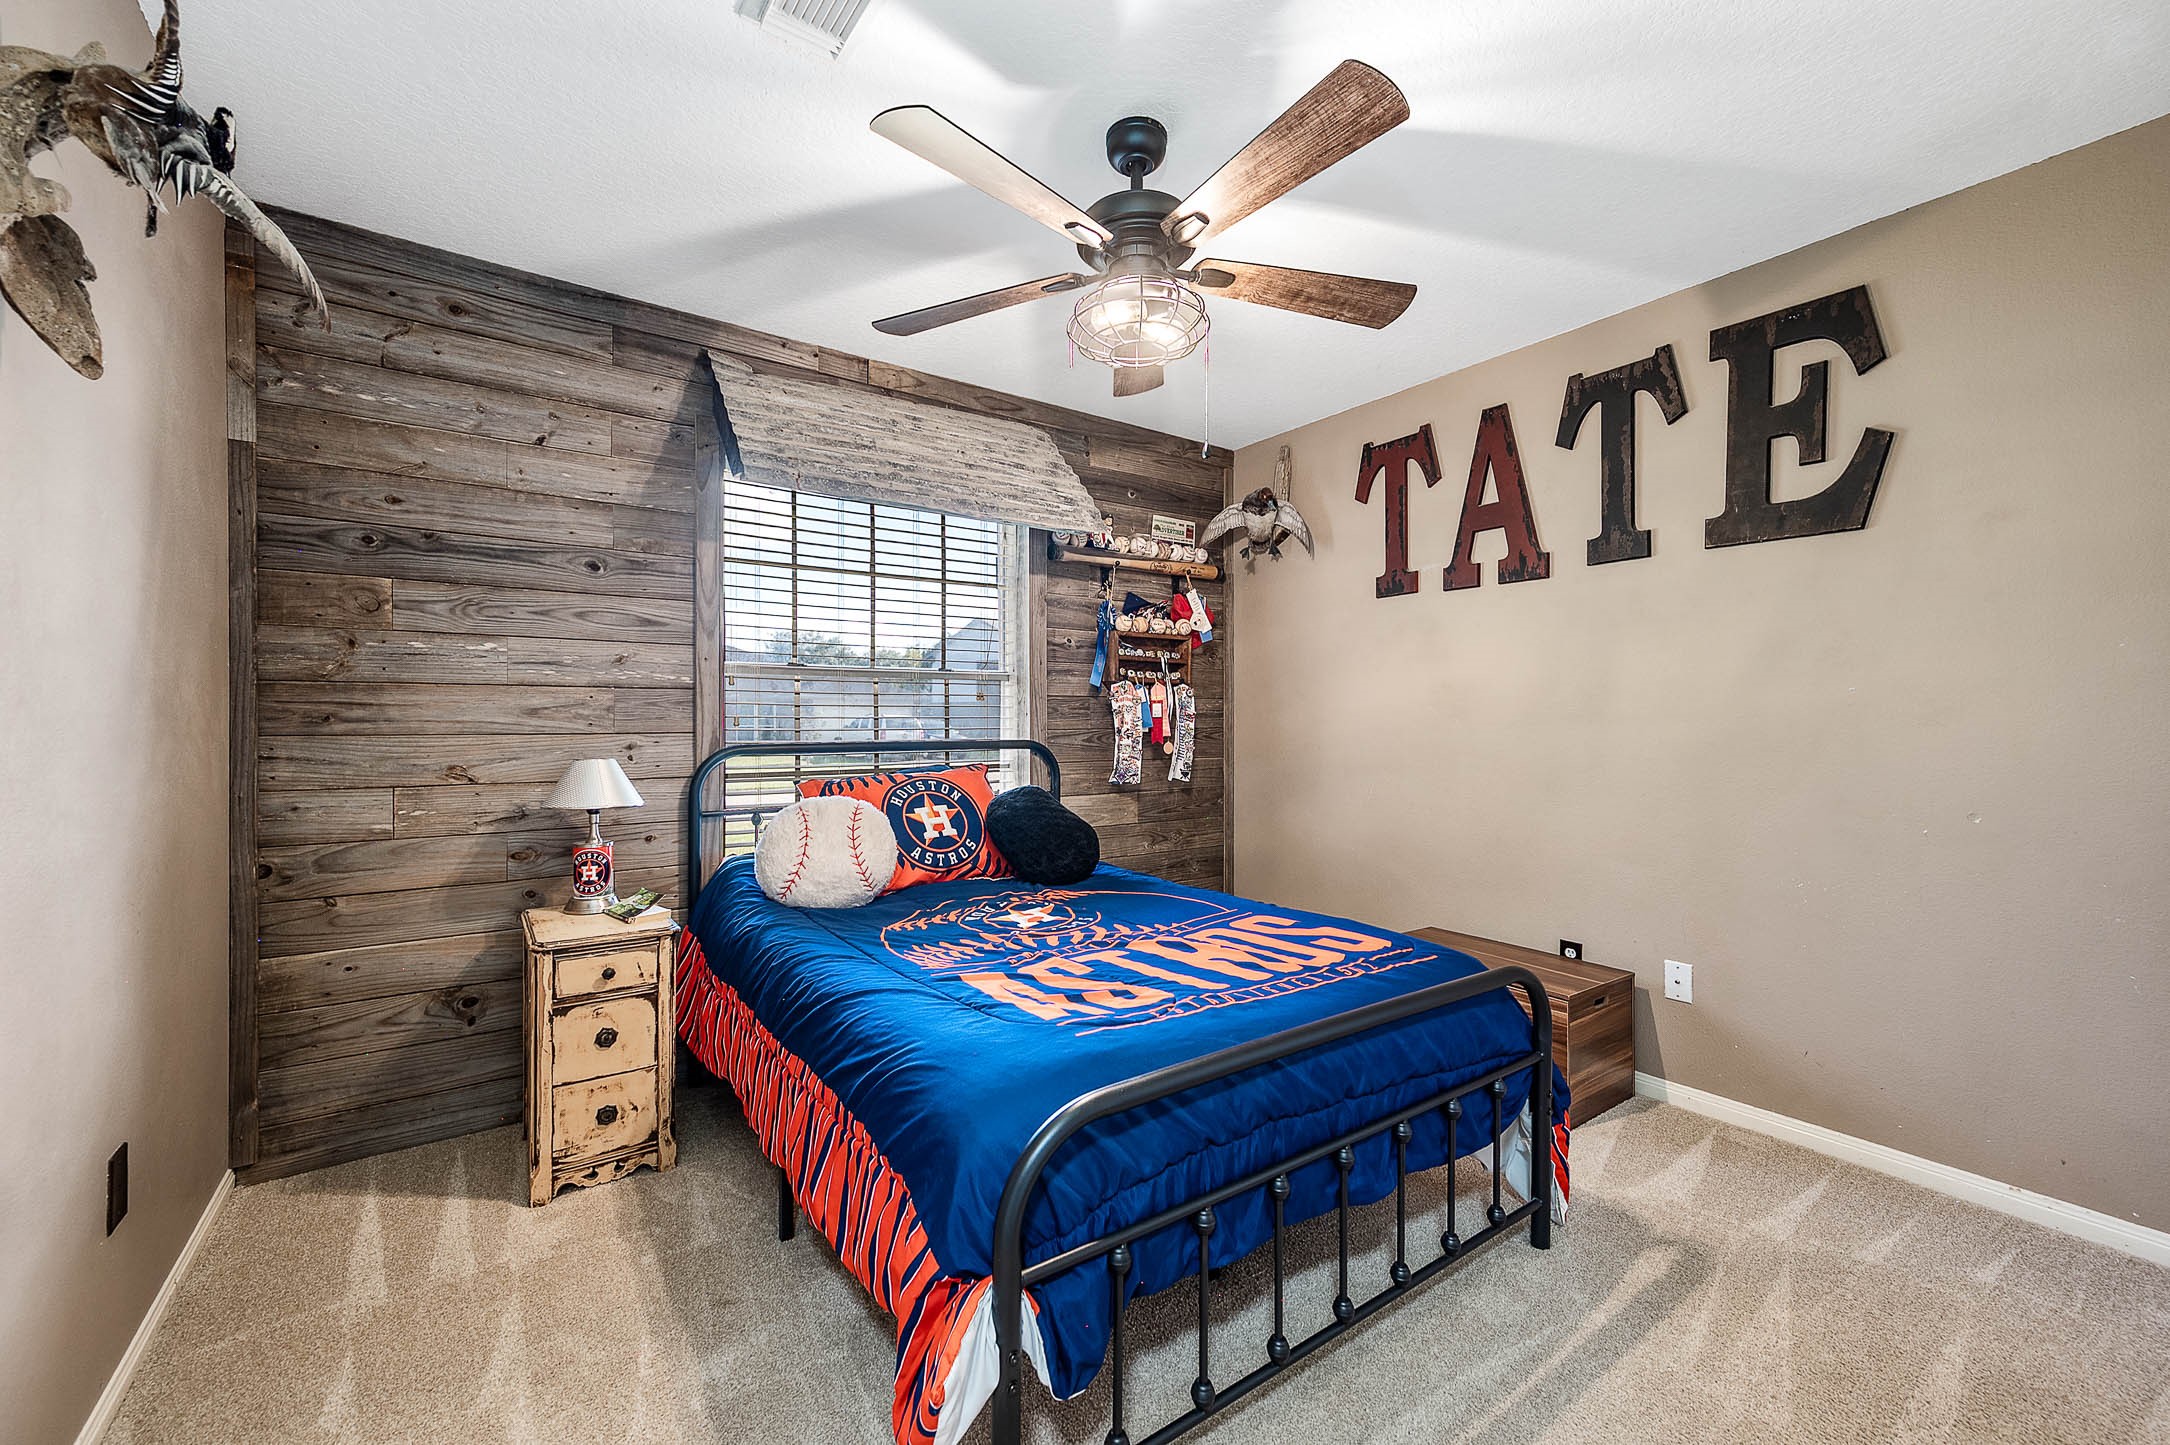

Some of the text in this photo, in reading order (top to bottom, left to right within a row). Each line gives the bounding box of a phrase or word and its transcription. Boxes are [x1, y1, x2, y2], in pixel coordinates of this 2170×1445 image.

[1354, 284, 1895, 599] TATE
[889, 780, 962, 808] HOUSTON
[913, 804, 958, 840] H
[575, 853, 607, 865] HOUSTON
[910, 838, 976, 867] ASTROS
[576, 881, 606, 893] ASTROS
[581, 865, 598, 881] H
[959, 915, 1393, 1020] ASTROS
